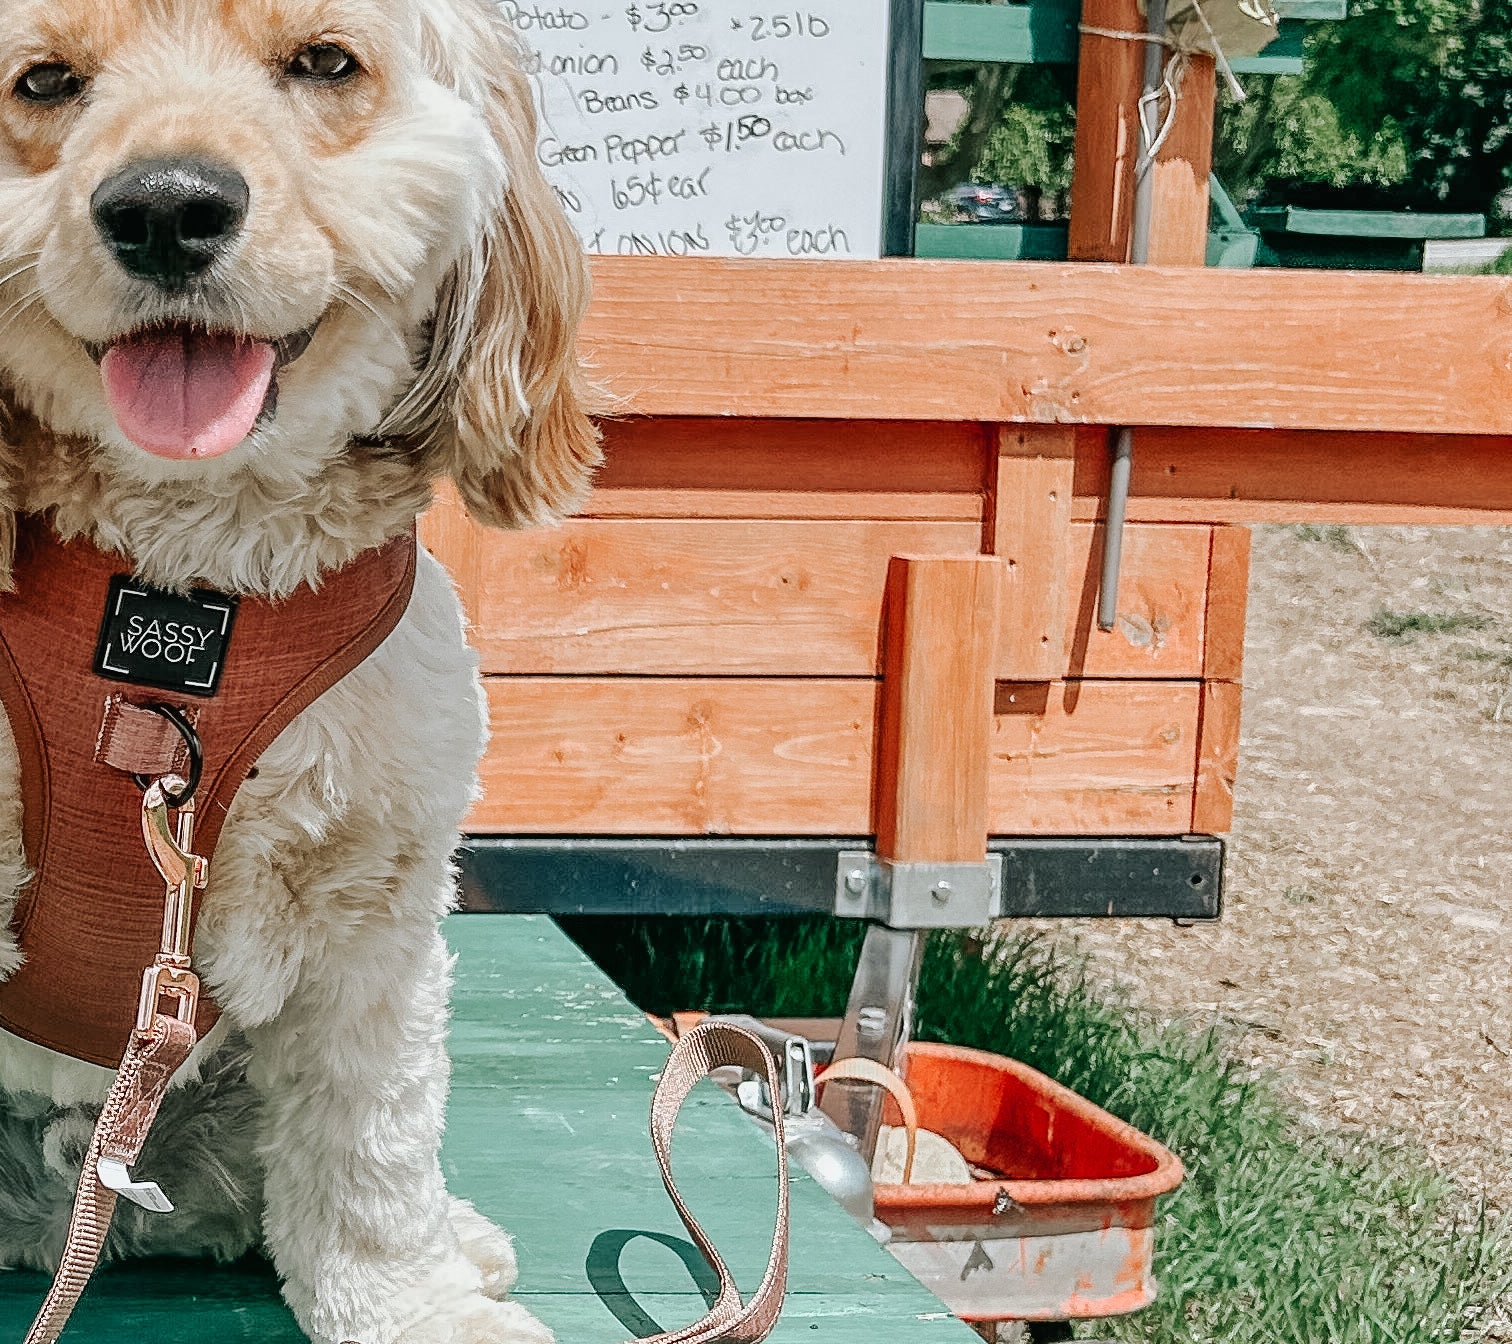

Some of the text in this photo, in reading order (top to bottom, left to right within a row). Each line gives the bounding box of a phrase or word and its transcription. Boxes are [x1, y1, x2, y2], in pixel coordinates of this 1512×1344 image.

[498, 0, 588, 30] Potato
[717, 56, 779, 82] each
[578, 90, 659, 113] Beans
[787, 223, 851, 255] each
[128, 615, 215, 647] SASSY
[120, 632, 205, 665] WOOF
